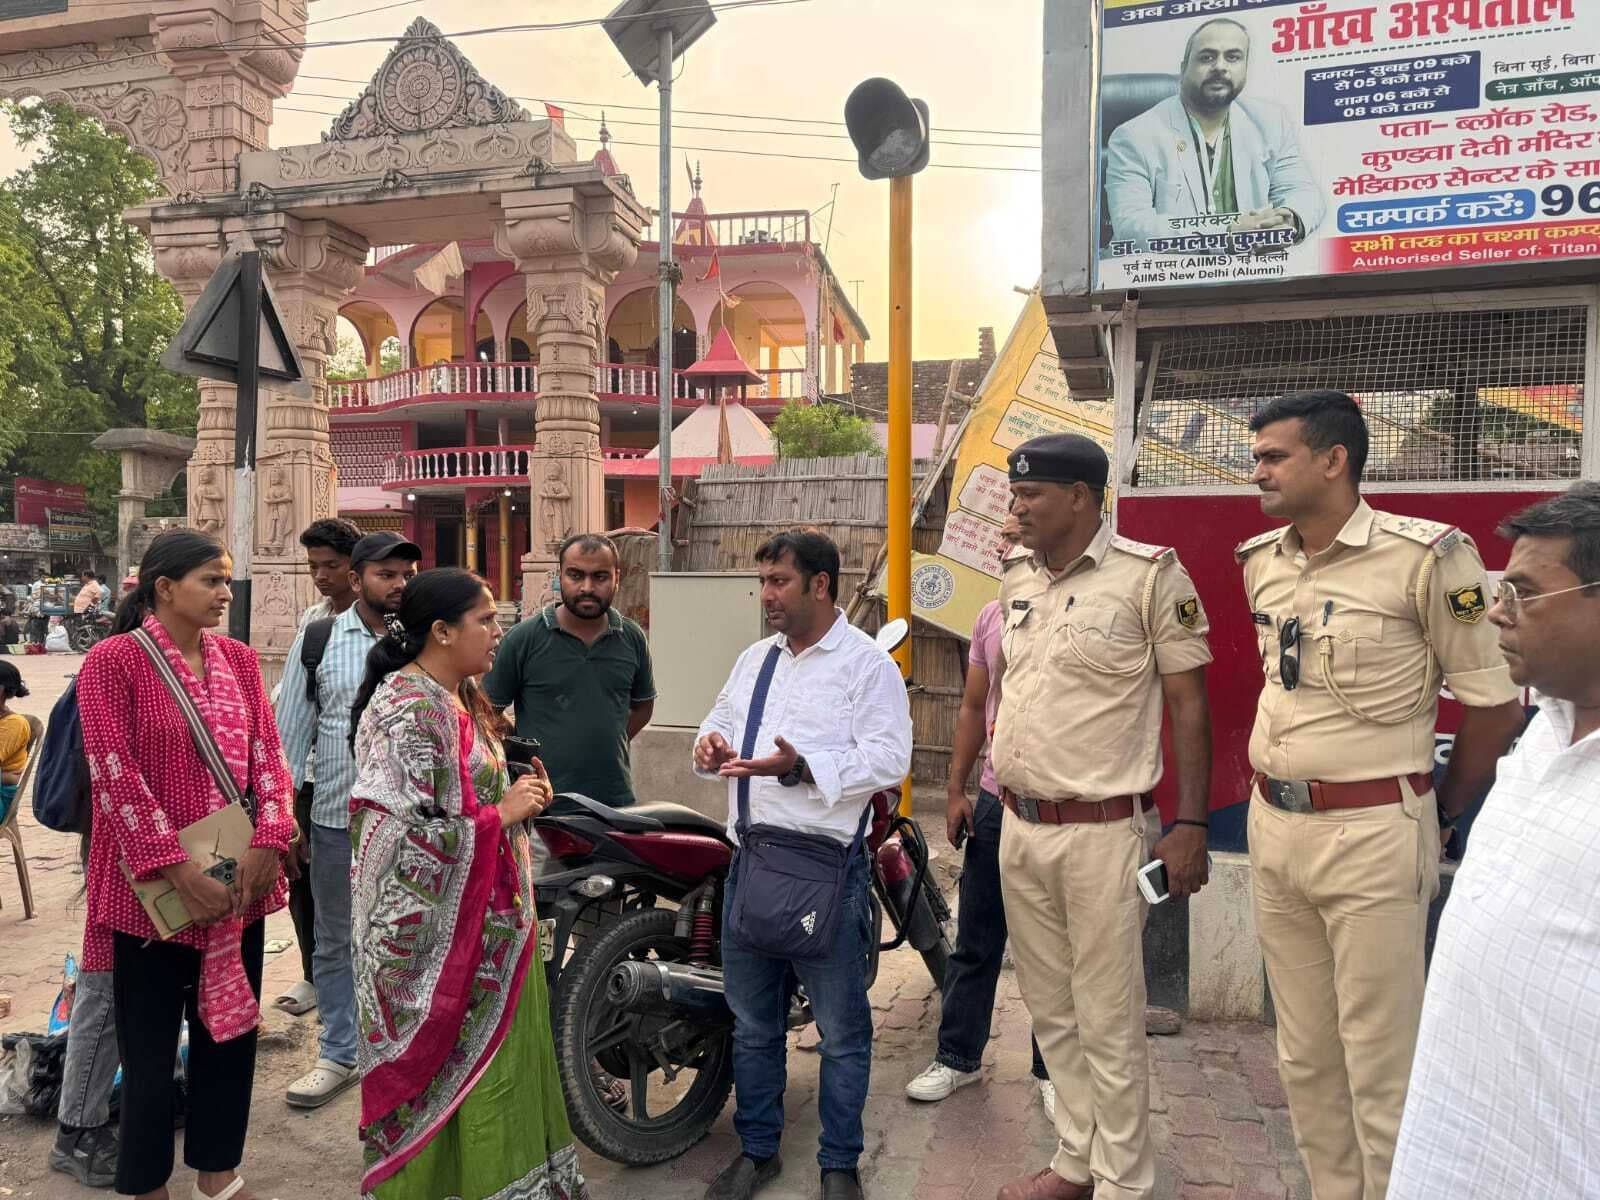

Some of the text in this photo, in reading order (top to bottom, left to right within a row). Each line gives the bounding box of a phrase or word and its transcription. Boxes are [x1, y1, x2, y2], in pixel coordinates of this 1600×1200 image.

[1121, 4, 1165, 21] अब
[1272, 0, 1576, 53] आँख अस्पताल
[1368, 61, 1412, 77] सुबह
[1413, 57, 1437, 69] 09
[1441, 54, 1472, 66] बजे
[1493, 61, 1526, 74] बिना
[1562, 53, 1595, 67] बिना
[1334, 70, 1448, 91] से 05 बजे तक
[1495, 82, 1519, 96] नेत्र
[1334, 84, 1452, 107] शाम 06 बजे से
[1343, 100, 1437, 118] 08 बजे तक
[1455, 107, 1536, 132] ब्लॉक
[1541, 102, 1598, 124] रोड,
[1460, 134, 1513, 158] देवी
[1518, 129, 1596, 152] मंदिर
[1332, 172, 1441, 197] मेडिकल
[1443, 166, 1522, 188] सेन्टर
[1526, 159, 1559, 181] के
[1167, 212, 1242, 230] डायरेक्टर
[1344, 197, 1451, 229] सम्पर्क
[1147, 232, 1229, 253] कमलेश
[1231, 228, 1294, 252] कुमार
[1350, 236, 1396, 254] सभी
[1399, 233, 1445, 250] तरह
[1448, 231, 1478, 249] का
[1483, 227, 1540, 245] चश्मा
[1123, 259, 1140, 276] पूर्व
[1142, 258, 1154, 271] में
[1180, 253, 1233, 270] (AIIMS)
[1352, 242, 1597, 268] Authorised Seller of: Titan
[1132, 265, 1285, 284] AIIMS New Delhi (Alumni)
